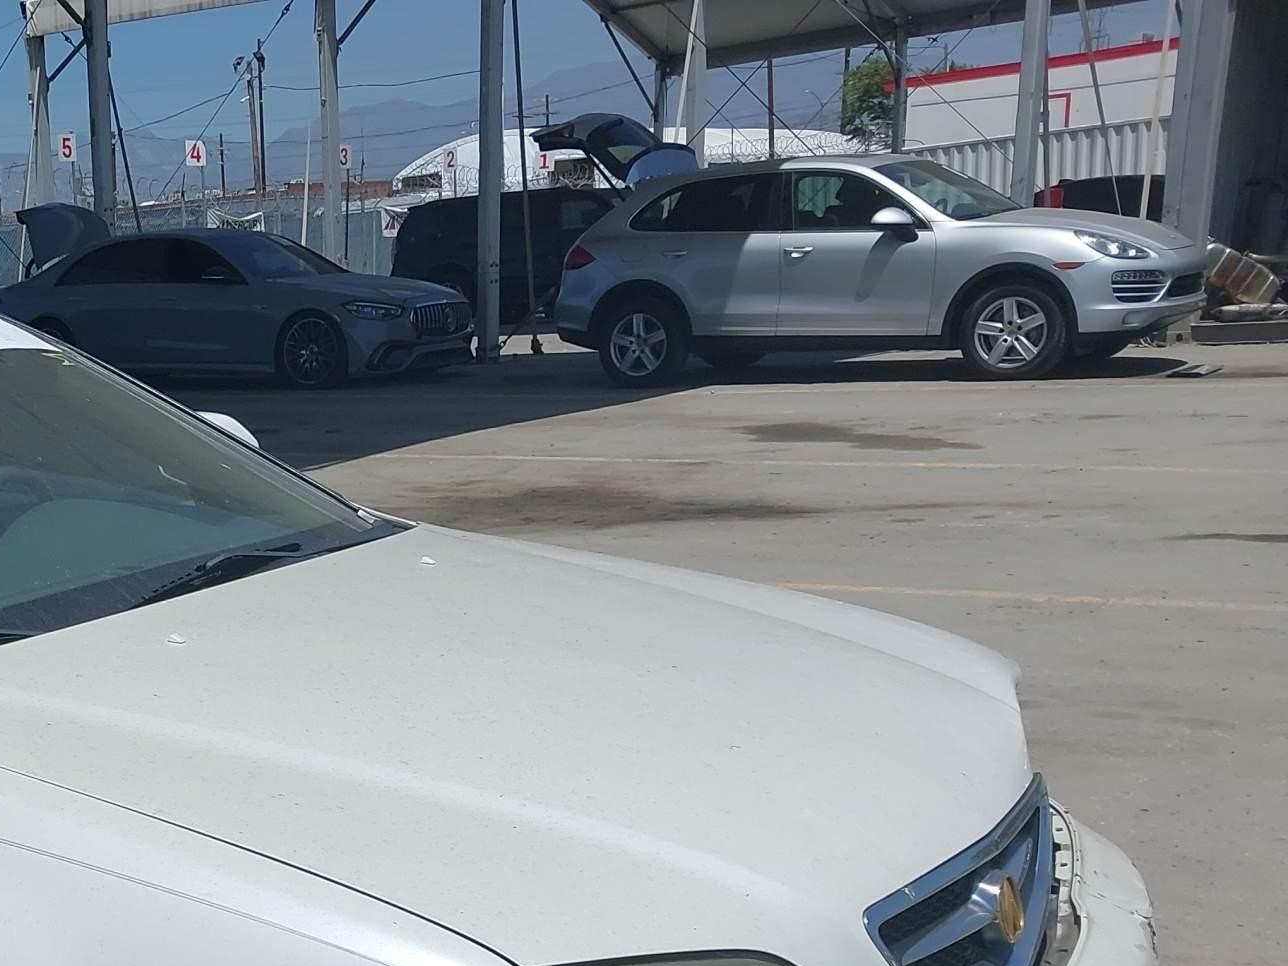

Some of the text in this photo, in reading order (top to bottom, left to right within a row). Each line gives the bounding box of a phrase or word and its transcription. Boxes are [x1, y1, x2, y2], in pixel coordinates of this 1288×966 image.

[62, 137, 72, 158] 5
[190, 143, 202, 163] 4
[339, 147, 348, 166] 3
[446, 150, 455, 168] 2
[538, 152, 550, 170] 1
